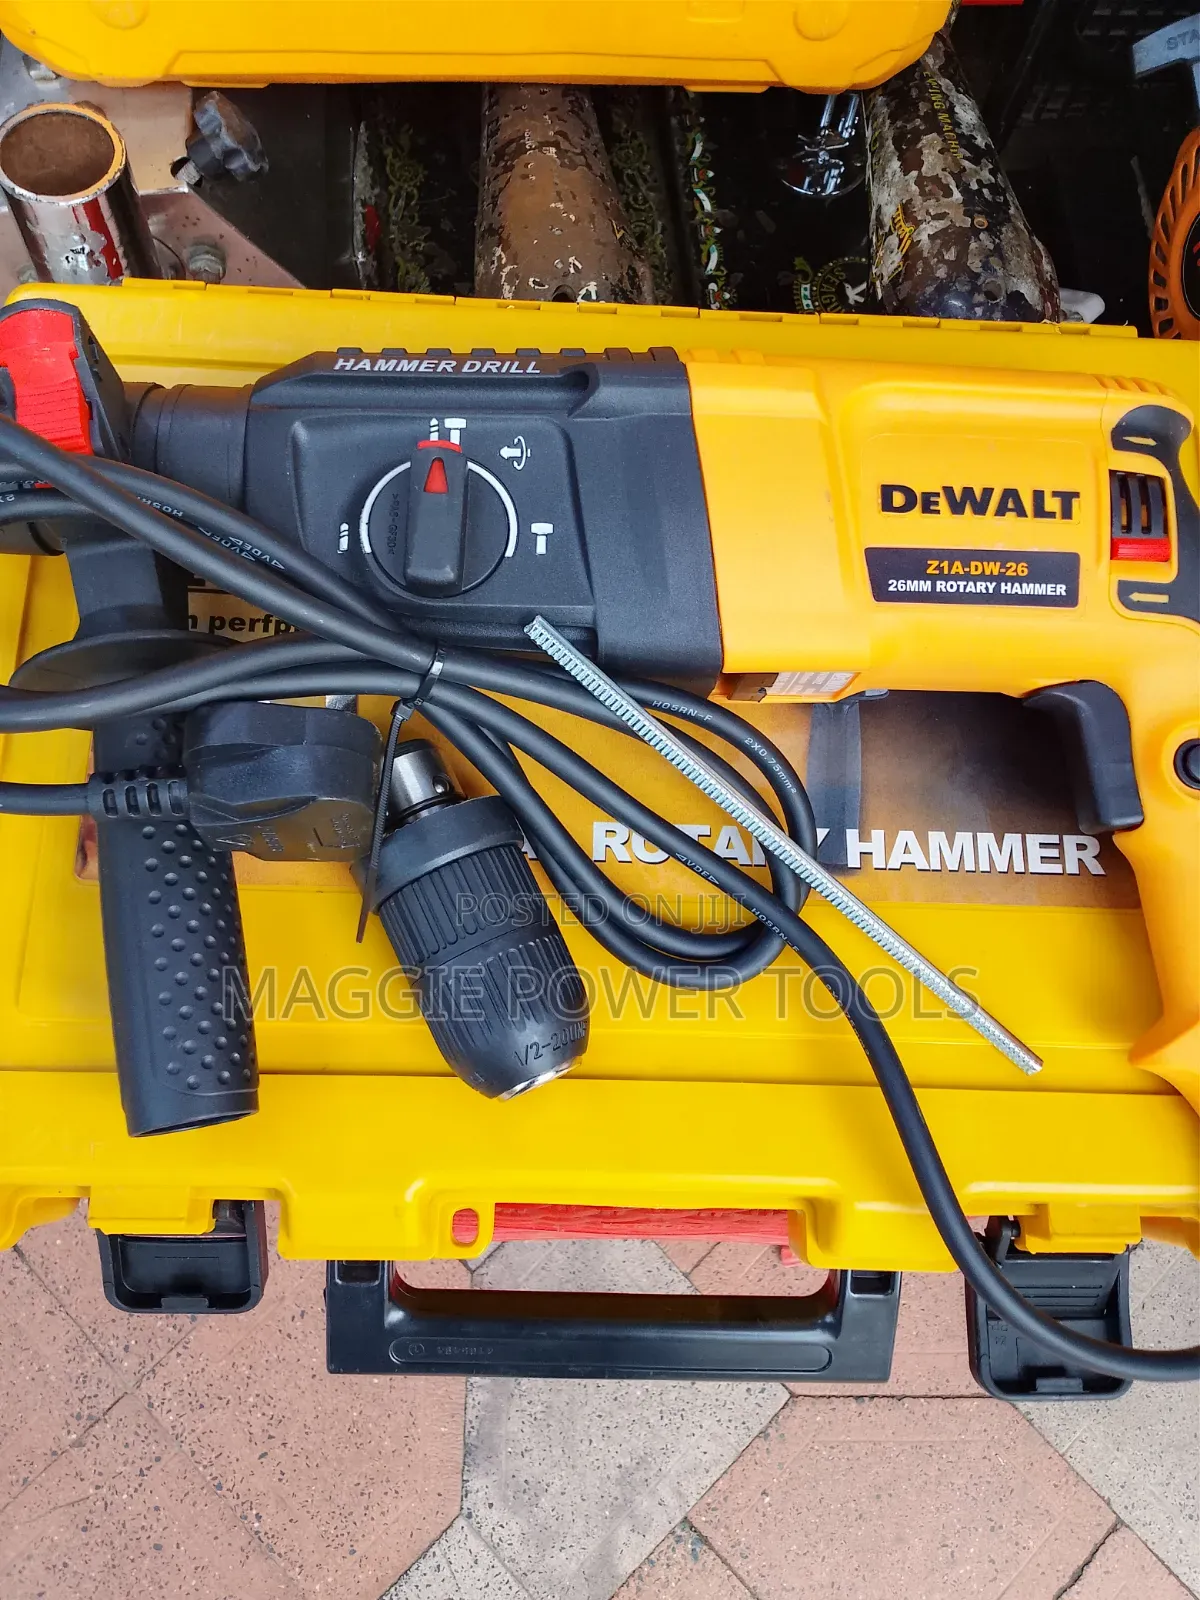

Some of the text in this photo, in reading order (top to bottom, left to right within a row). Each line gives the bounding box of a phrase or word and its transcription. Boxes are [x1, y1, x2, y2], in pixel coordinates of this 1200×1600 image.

[333, 358, 541, 374] HAMMER DRILL
[926, 560, 1029, 577] Z1A-DW-26
[888, 580, 1067, 596] 26MM ROTARY HAMMER
[846, 828, 1106, 876] HAMMER
